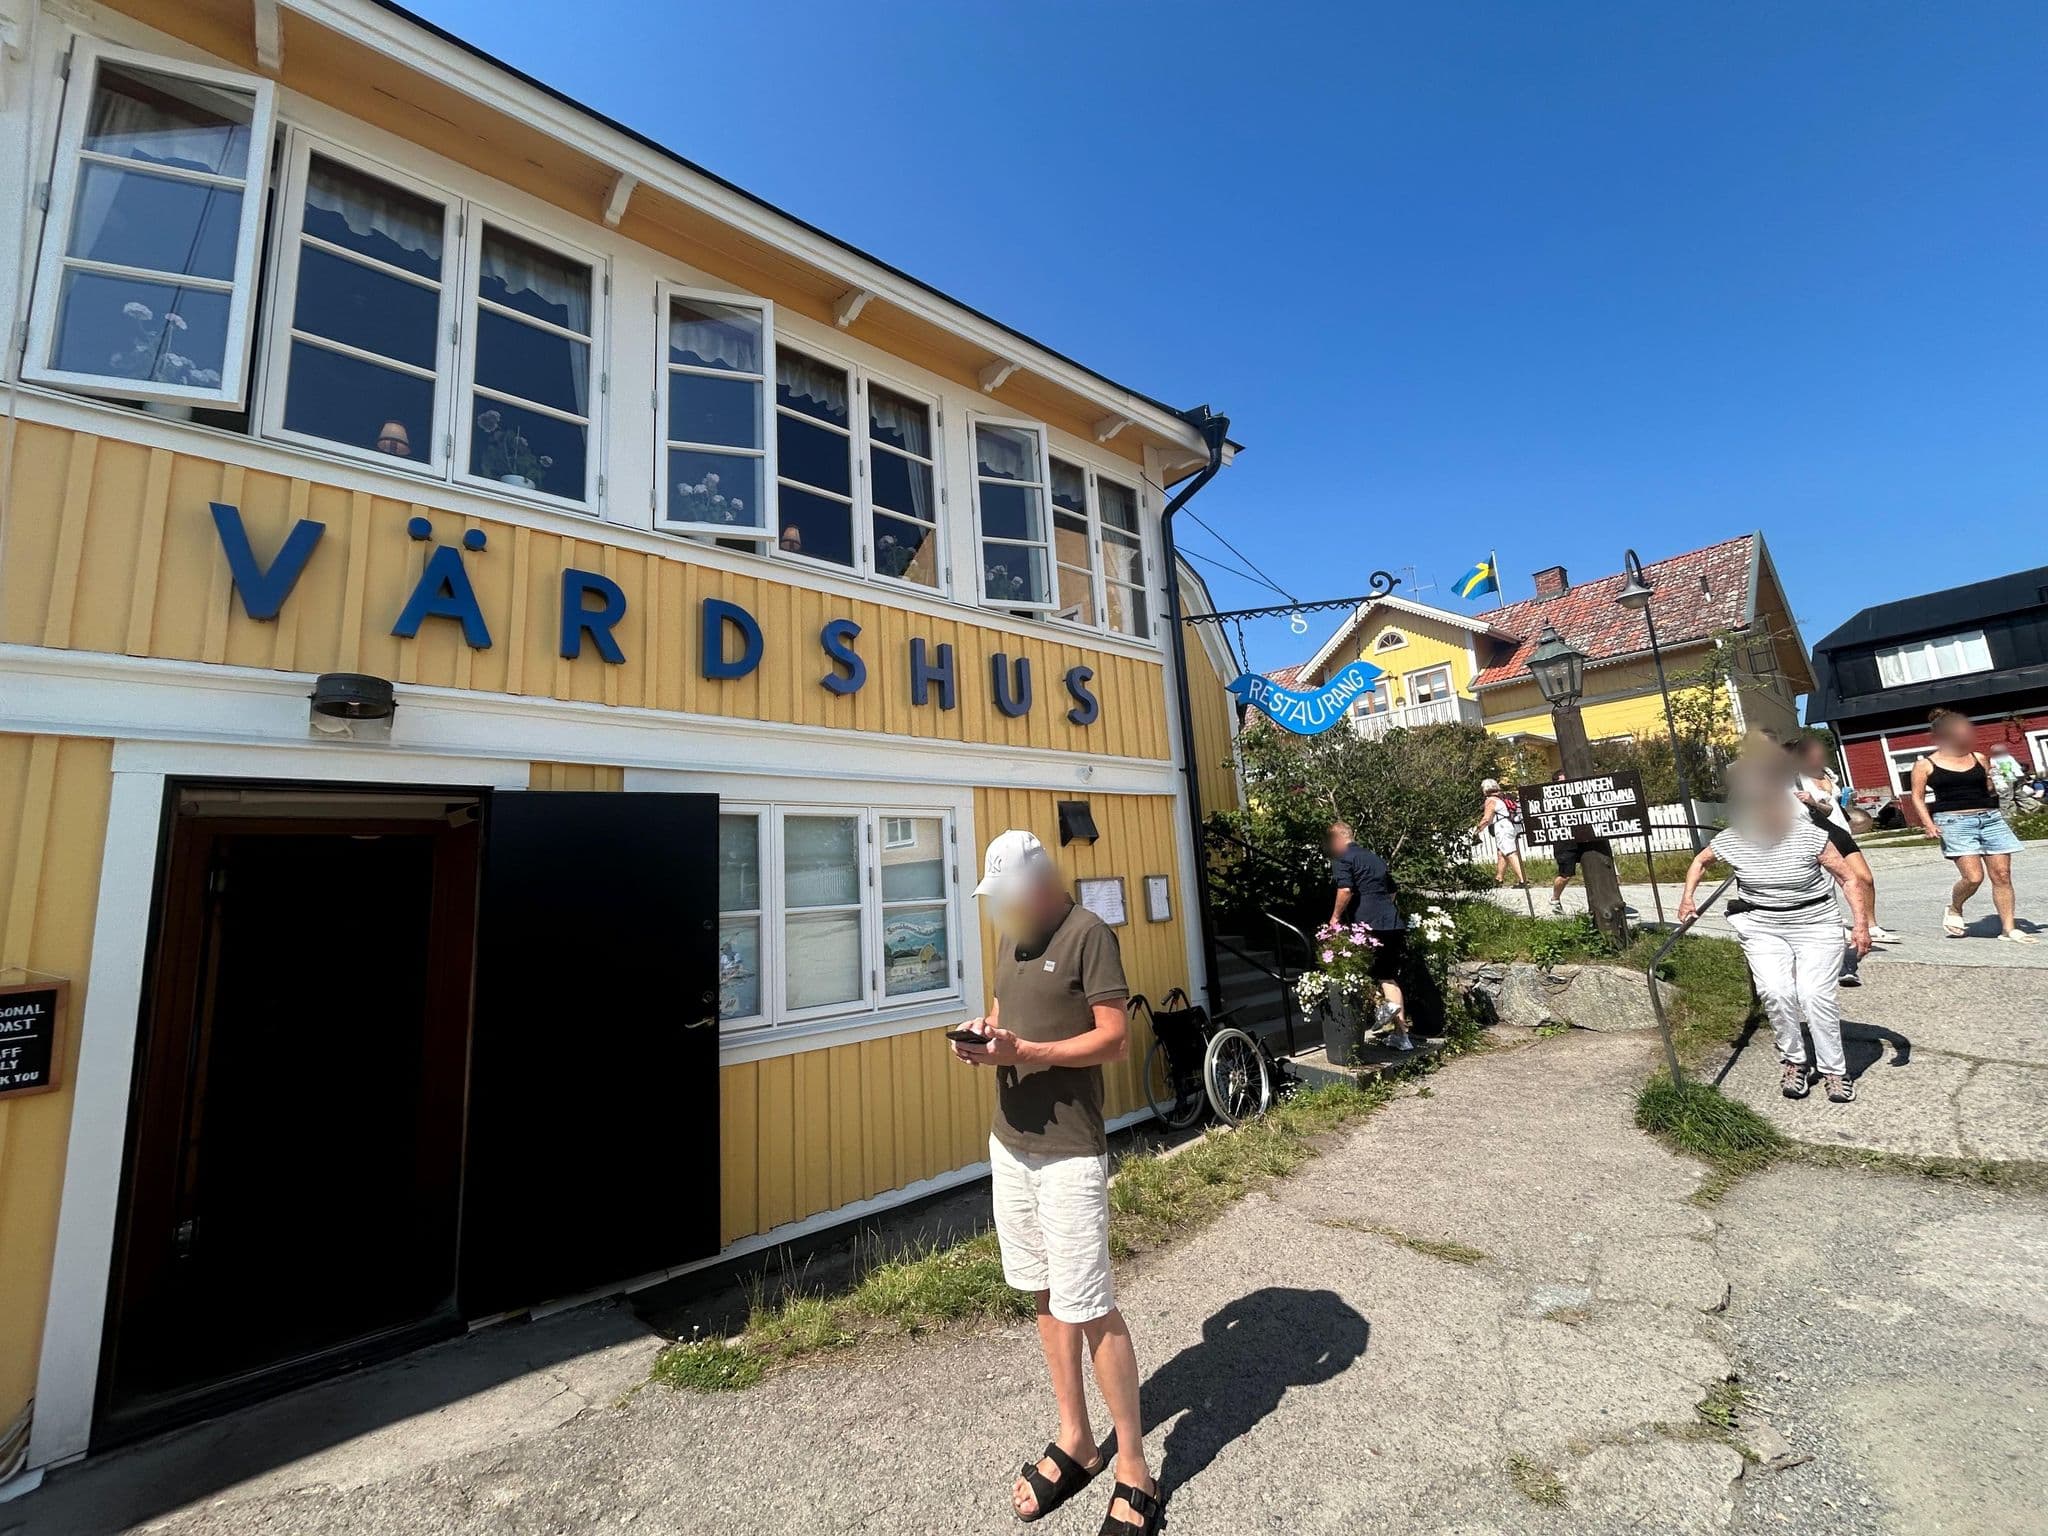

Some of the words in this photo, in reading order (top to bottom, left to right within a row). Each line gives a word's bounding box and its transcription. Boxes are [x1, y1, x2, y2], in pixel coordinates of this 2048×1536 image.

[209, 501, 1100, 727] VÄRDSHUS
[1249, 669, 1364, 727] RESTAURANG
[1542, 776, 1614, 799] RESTAURANGEN
[1528, 800, 1541, 814] ÄR
[1582, 788, 1636, 807] VÄLKOMNA
[1533, 830, 1546, 843] IS
[1592, 818, 1642, 837] WELCOME
[1538, 814, 1557, 829] THE
[1559, 807, 1618, 827] RESTAURANT
[14, 1071, 39, 1082] YOU
